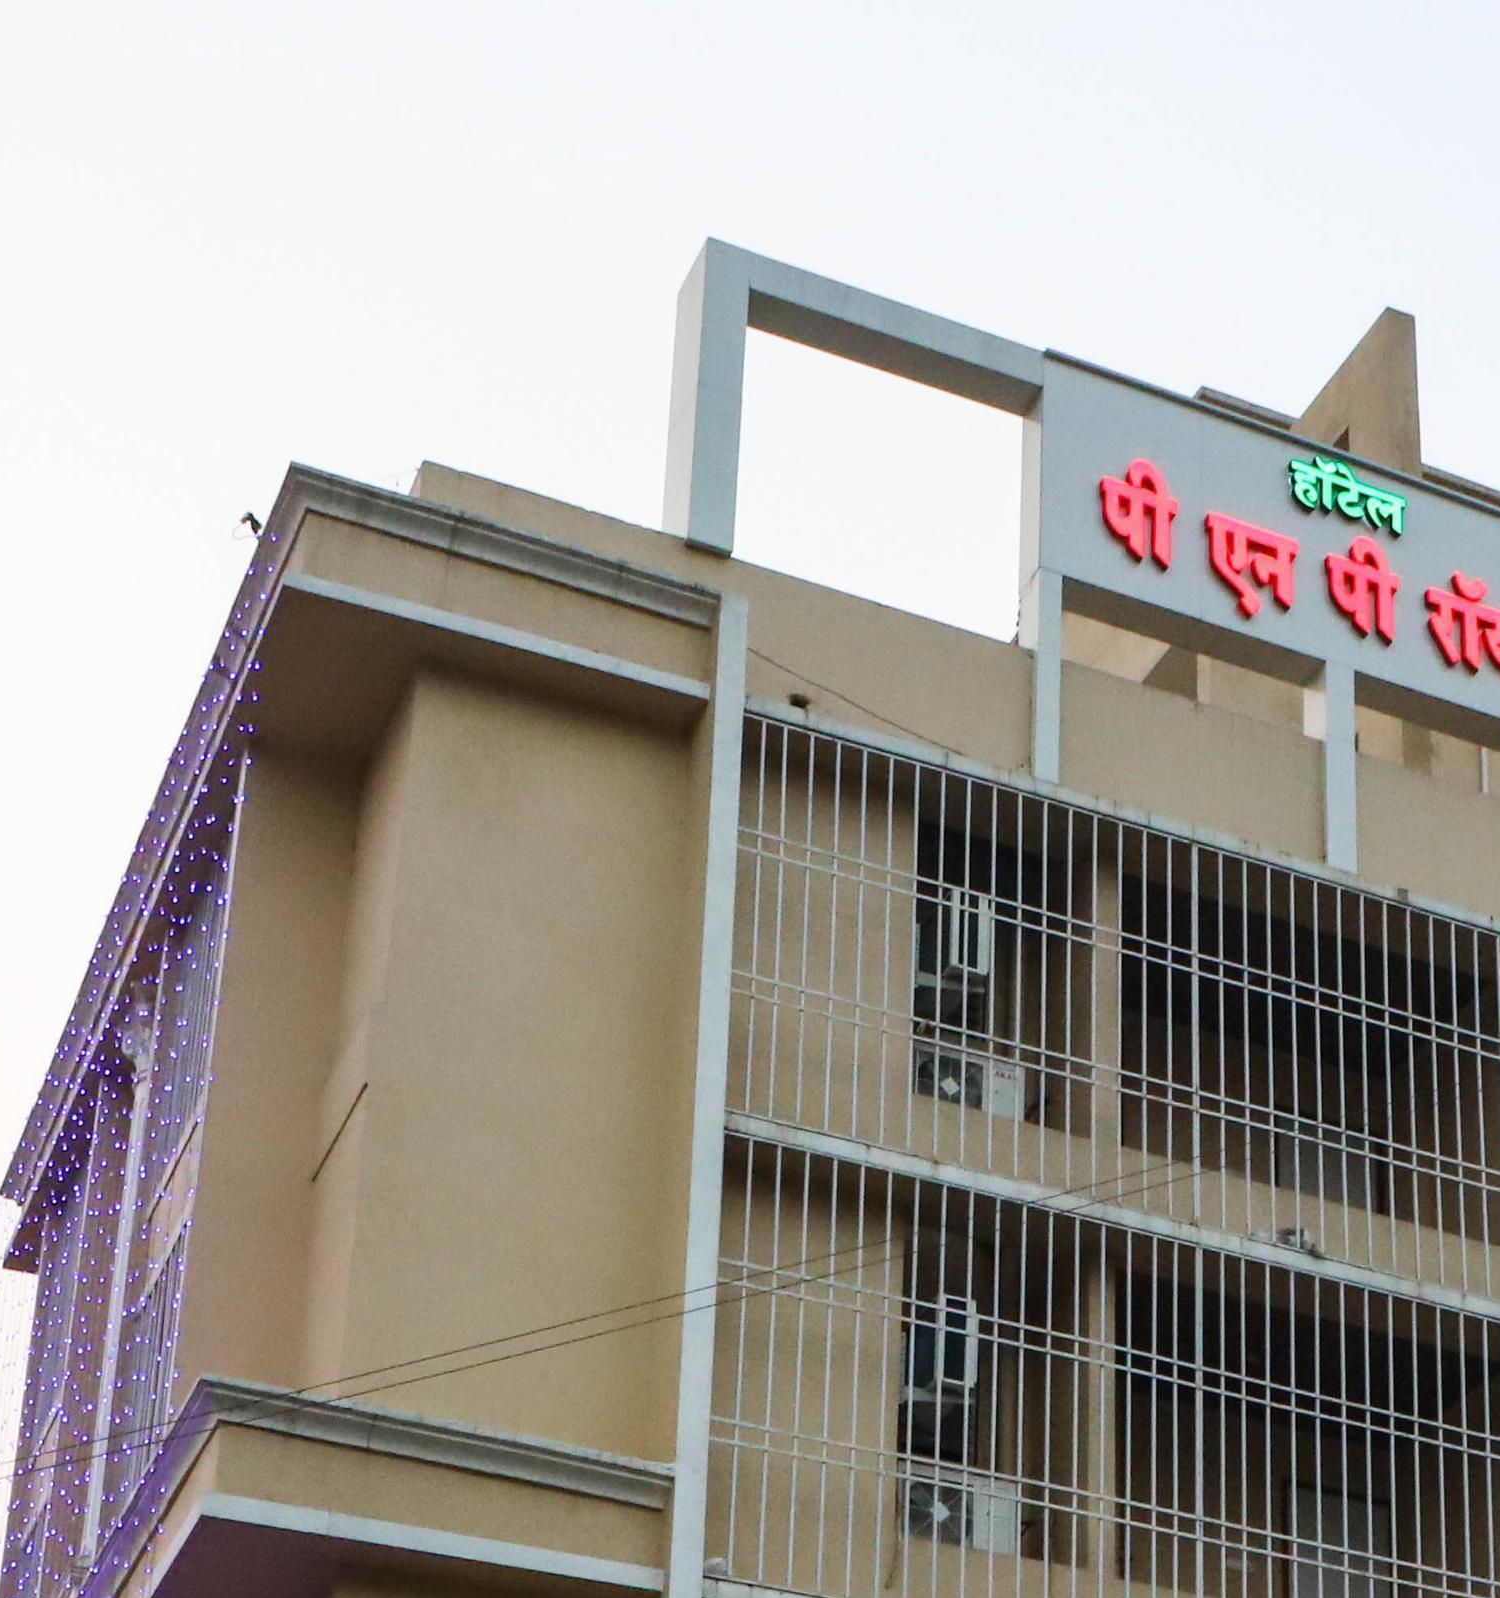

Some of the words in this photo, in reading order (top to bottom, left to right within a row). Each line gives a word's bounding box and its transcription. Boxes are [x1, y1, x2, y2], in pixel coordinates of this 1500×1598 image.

[1099, 458, 1179, 570] पी
[1204, 511, 1300, 618] एन
[1324, 535, 1400, 644] पी
[1288, 454, 1407, 535] हॉटेल
